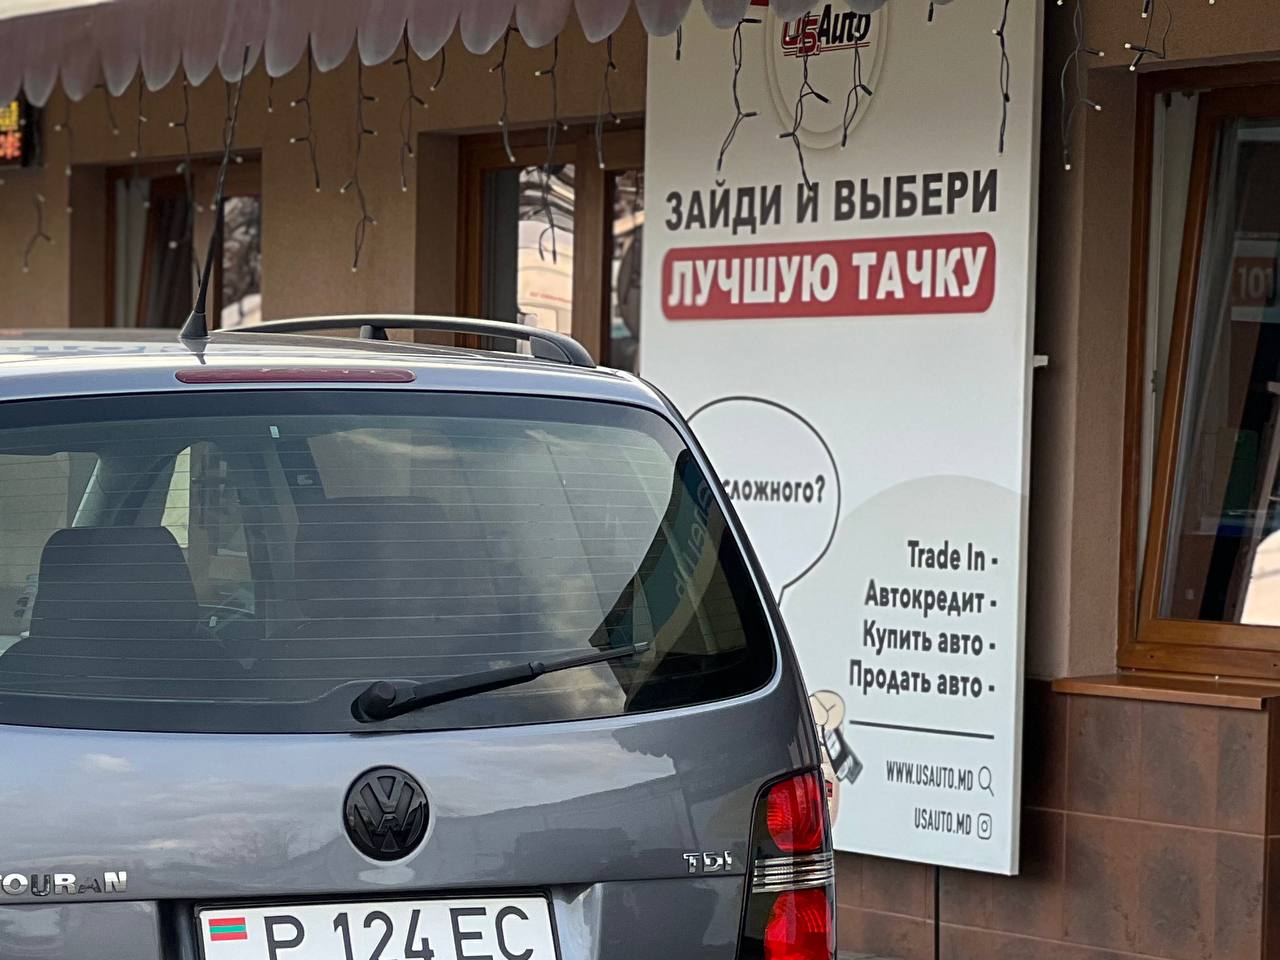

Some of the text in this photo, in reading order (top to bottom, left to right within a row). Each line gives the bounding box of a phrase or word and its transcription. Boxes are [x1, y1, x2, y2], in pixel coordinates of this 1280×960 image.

[665, 169, 997, 235] ЗАЙДИ И ВЫБЕРИ
[668, 246, 987, 306] ЛУЧШУЮ ТАЧКУ
[907, 540, 985, 571] Trade In
[864, 579, 985, 618] Автокредит
[863, 619, 983, 656] Купить авто
[849, 659, 982, 698] Продать авто
[886, 760, 974, 791] WWW.USAUTO.MD
[914, 807, 972, 835] USAUTO.MD
[683, 850, 732, 873] TDI
